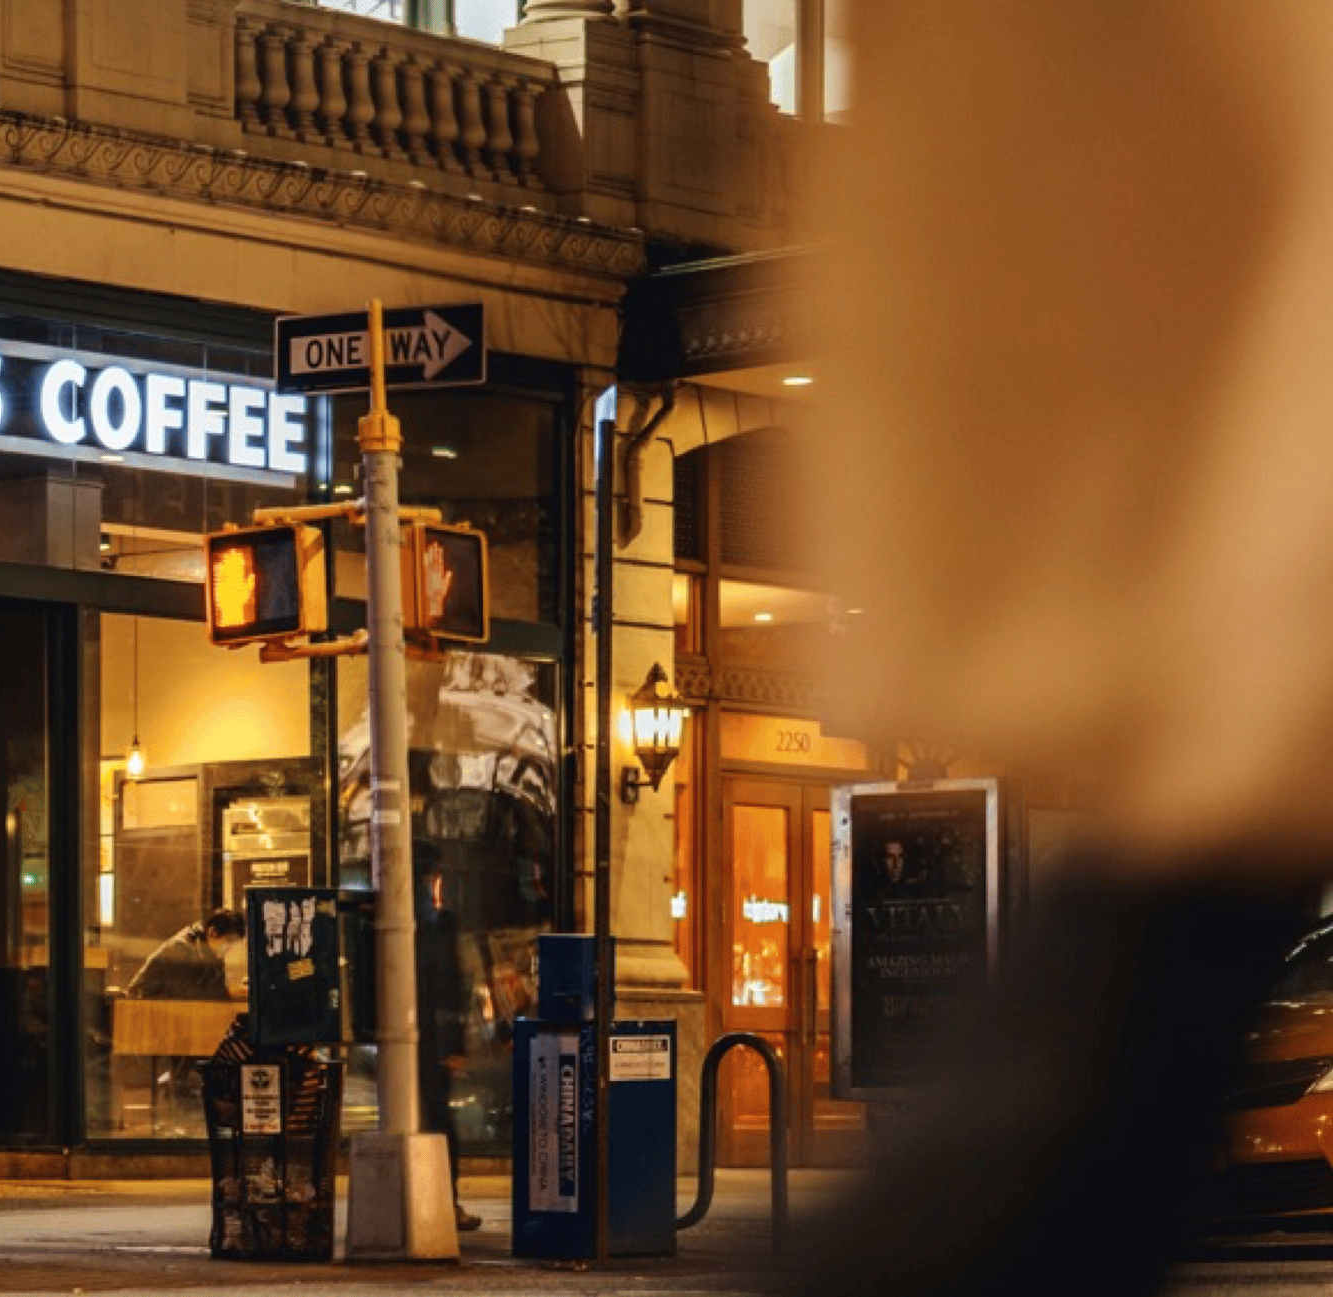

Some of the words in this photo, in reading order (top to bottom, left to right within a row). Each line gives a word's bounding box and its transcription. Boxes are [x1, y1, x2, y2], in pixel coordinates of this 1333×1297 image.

[305, 335, 363, 369] ONE
[390, 328, 451, 363] WAY
[39, 359, 308, 474] COFFEE
[776, 730, 812, 754] 2250
